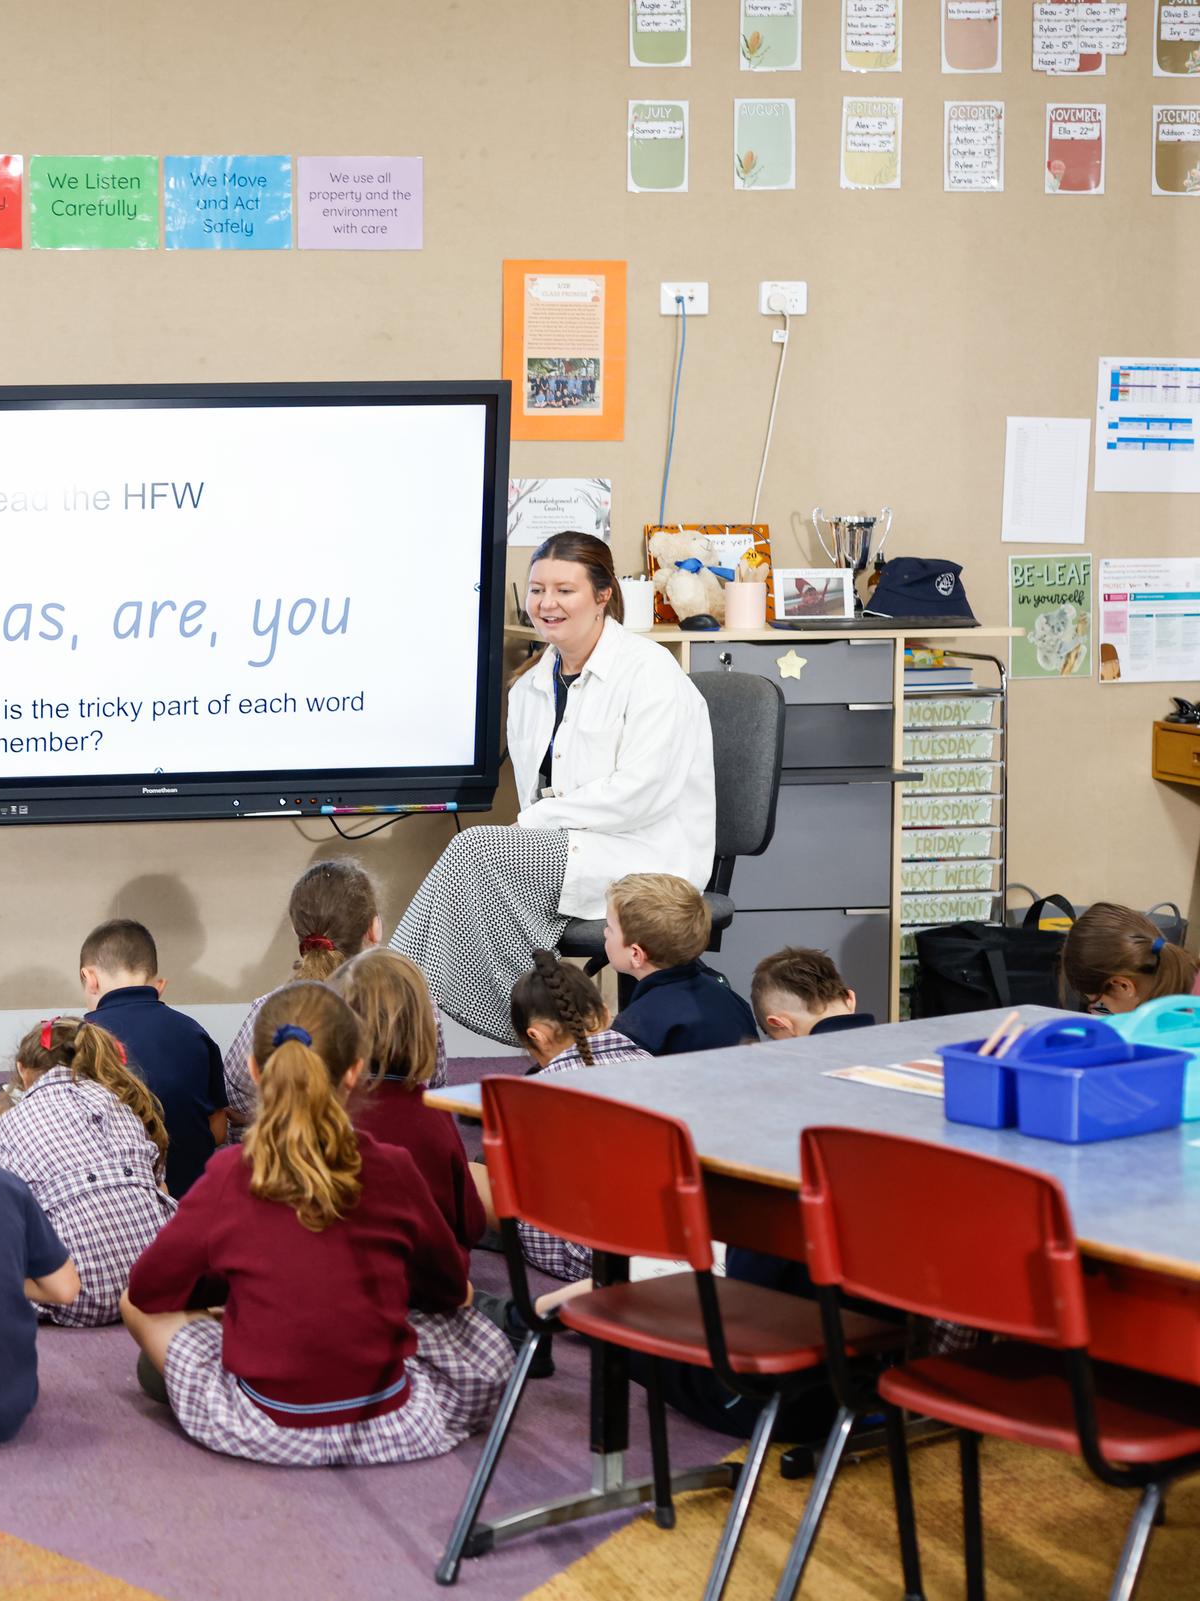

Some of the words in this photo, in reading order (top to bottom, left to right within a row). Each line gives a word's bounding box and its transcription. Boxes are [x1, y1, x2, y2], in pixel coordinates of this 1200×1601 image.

[1040, 7, 1057, 16] Beau
[1085, 7, 1101, 16] Cleo
[1039, 24, 1058, 34] Rylan
[1080, 24, 1104, 34] George
[1041, 41, 1055, 50] Zeb
[1038, 57, 1057, 66] Hazel
[645, 106, 672, 120] JULY
[1049, 108, 1102, 122] NOVEMBER
[1058, 126, 1071, 136] Ella
[46, 172, 79, 190] We
[85, 172, 141, 190] Listen
[189, 172, 217, 187] We
[223, 172, 268, 188] Move
[329, 172, 350, 184] We
[353, 174, 374, 184] use
[377, 172, 391, 184] all
[309, 189, 362, 203] property
[365, 189, 389, 201] and
[392, 189, 412, 201] the
[51, 199, 138, 221] Carefully
[196, 197, 229, 211] and
[235, 197, 261, 211] Act
[322, 206, 399, 218] environment
[202, 217, 254, 237] Safely
[333, 222, 358, 234] with
[361, 224, 388, 234] care
[63, 482, 111, 512] the
[123, 482, 205, 510] HFW
[1012, 561, 1091, 588] BE-LEAF
[1018, 594, 1032, 605] in
[1033, 589, 1085, 608] yourself
[113, 600, 217, 648] are,
[247, 597, 351, 668] you
[3, 698, 23, 720] is
[31, 698, 69, 719] the
[78, 696, 143, 723] tricky
[152, 696, 200, 722] part
[207, 694, 232, 715] of
[238, 692, 297, 714] each
[306, 690, 365, 712] word
[908, 704, 972, 722] MONDAY
[911, 736, 977, 756] TUESDAY
[142, 786, 178, 795] Promethean
[901, 802, 981, 821] THURSDAY
[915, 836, 966, 854] FRIDAY
[945, 866, 985, 886] WEEK
[901, 899, 986, 919] SSESSMENT
